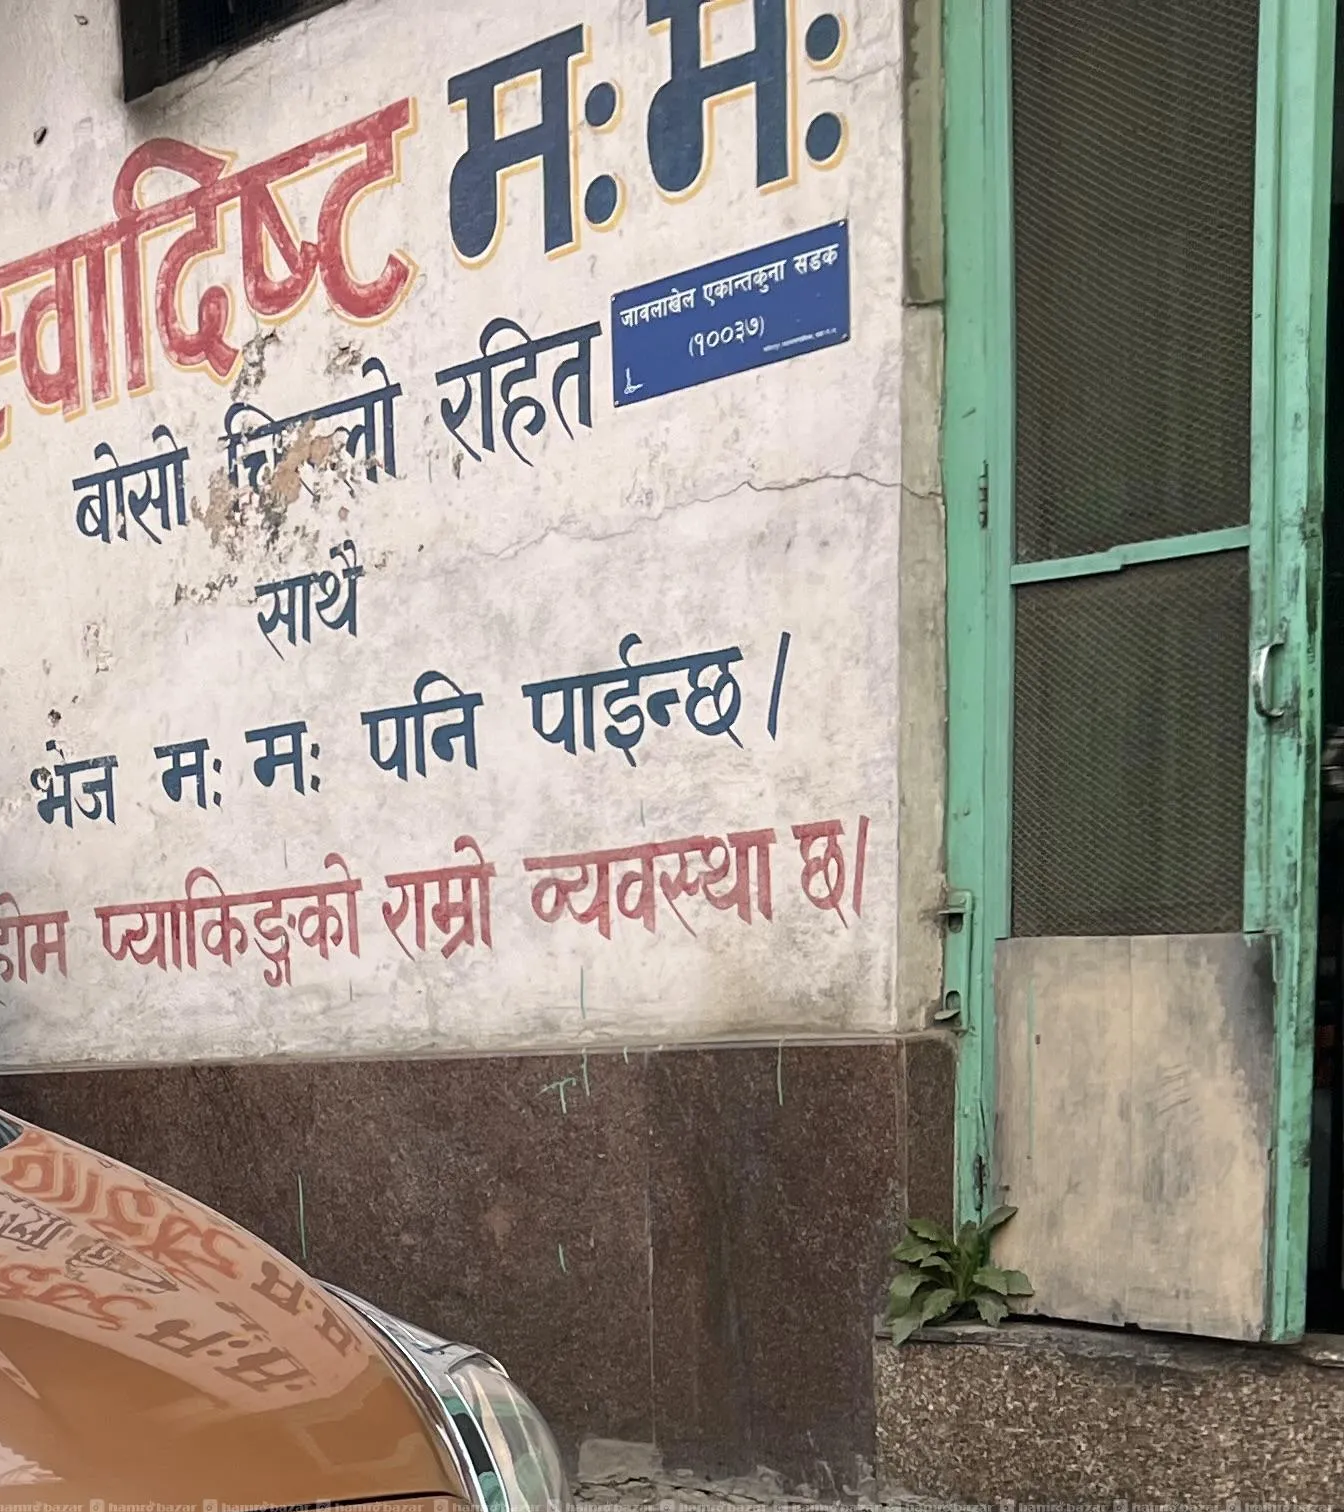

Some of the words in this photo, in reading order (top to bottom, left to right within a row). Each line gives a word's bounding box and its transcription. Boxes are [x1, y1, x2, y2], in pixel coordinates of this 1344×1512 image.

[620, 288, 696, 328] जावलाखेल
[703, 259, 787, 308] एकान्तकुना
[792, 243, 840, 275] सडक
[73, 425, 187, 544] बोसो
[437, 317, 602, 467] रहित
[256, 540, 363, 660] साथै
[362, 670, 483, 781] पनि
[383, 835, 496, 960] राम्रो
[524, 827, 776, 941] व्यवस्था
